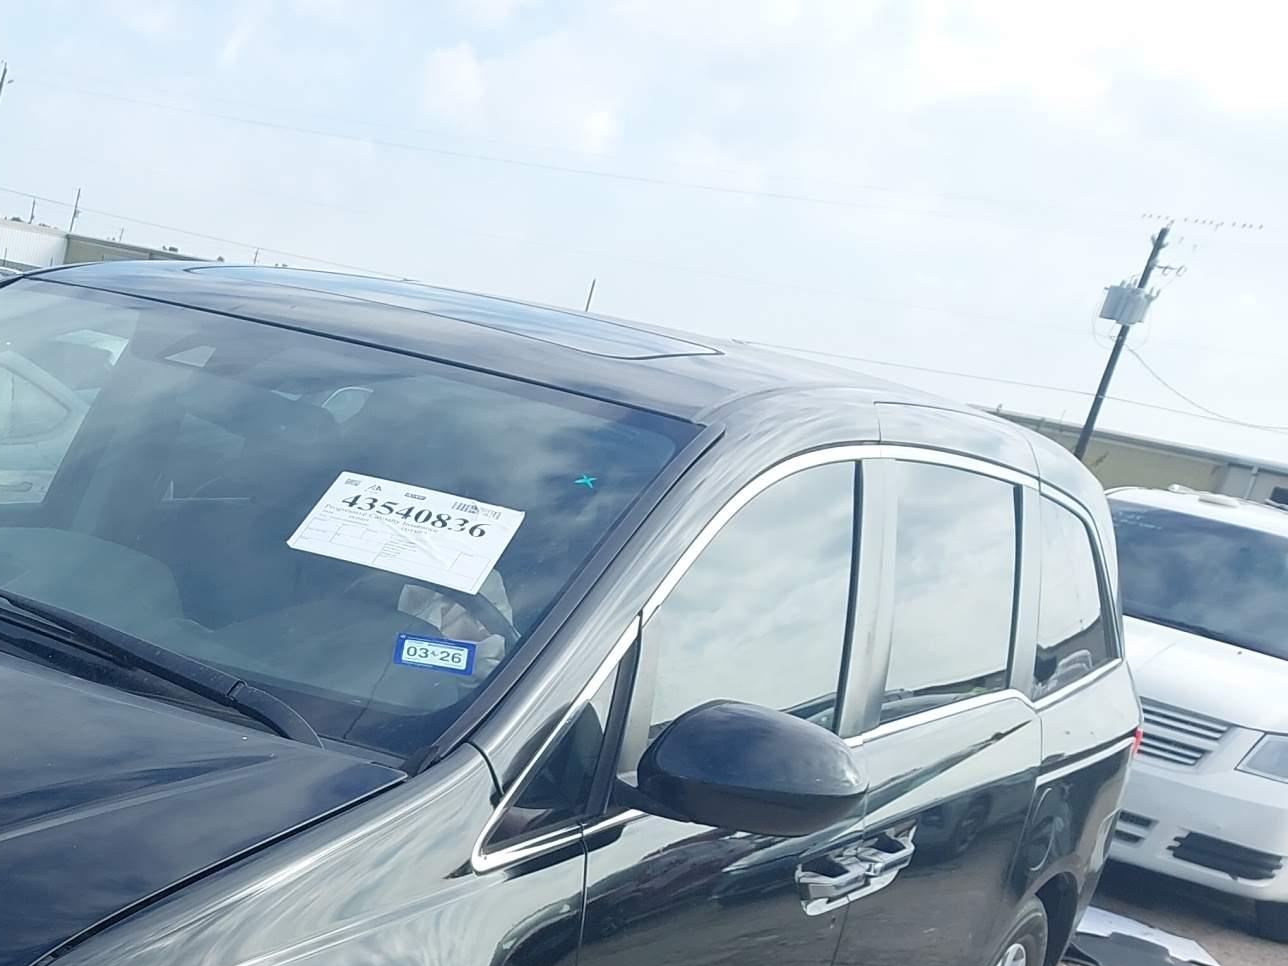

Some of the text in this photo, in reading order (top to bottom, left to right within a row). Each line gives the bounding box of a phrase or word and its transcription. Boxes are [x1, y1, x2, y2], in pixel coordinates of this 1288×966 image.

[342, 494, 491, 538] 43540836
[406, 646, 462, 664] 03 26
